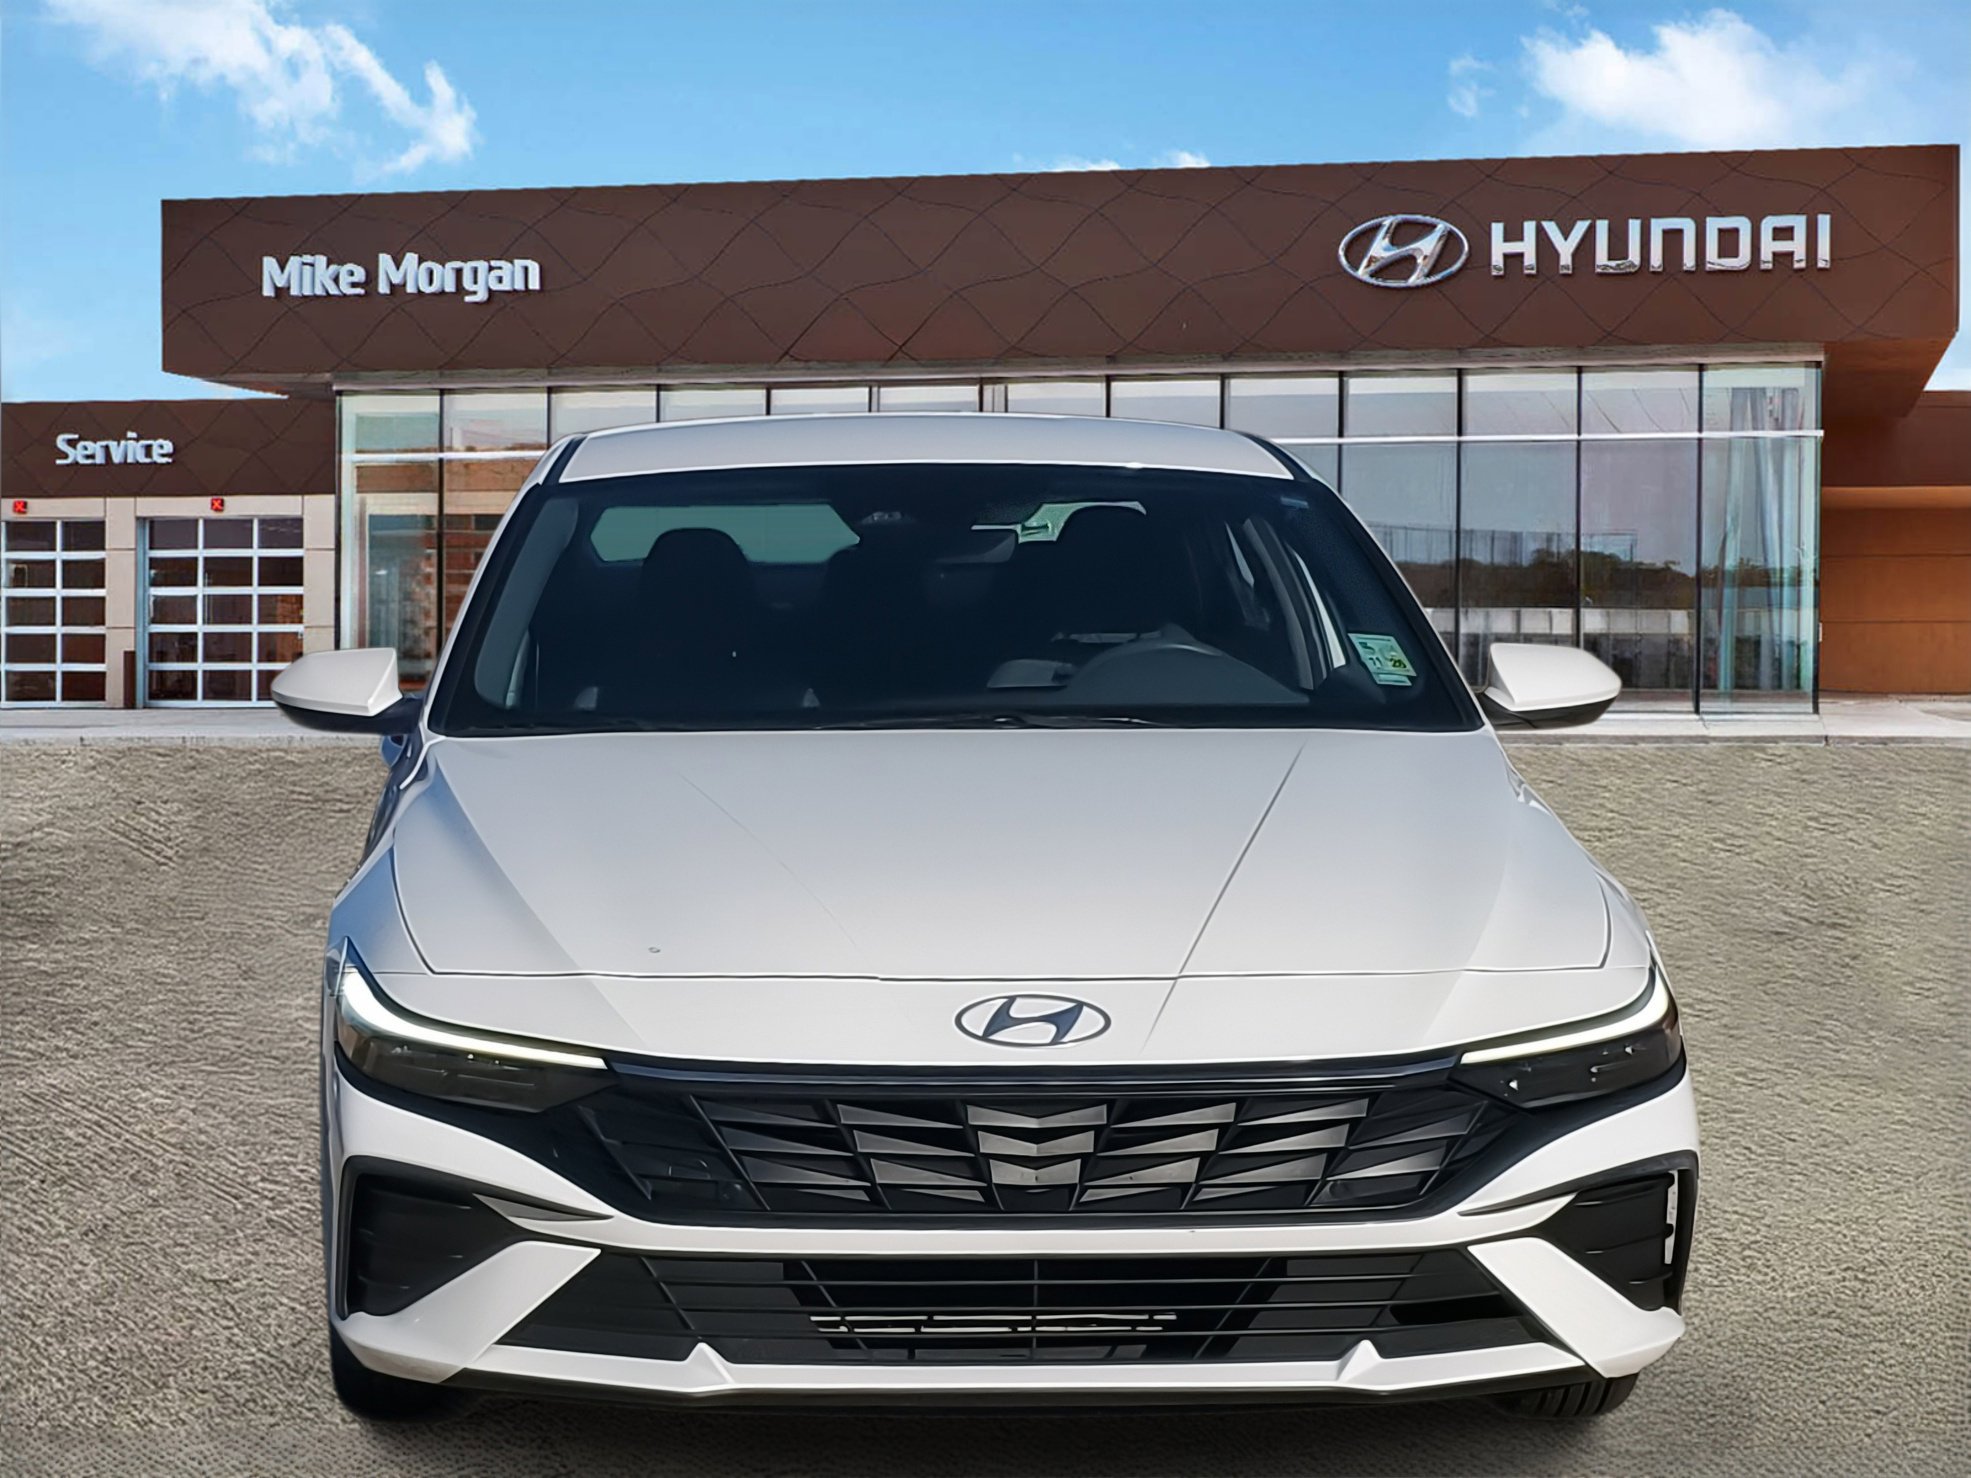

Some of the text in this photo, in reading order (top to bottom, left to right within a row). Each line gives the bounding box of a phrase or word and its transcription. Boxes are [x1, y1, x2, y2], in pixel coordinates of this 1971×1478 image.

[1490, 213, 1831, 276] HYUNDAI
[261, 251, 541, 303] Mike Morgan
[55, 430, 174, 466] Service
